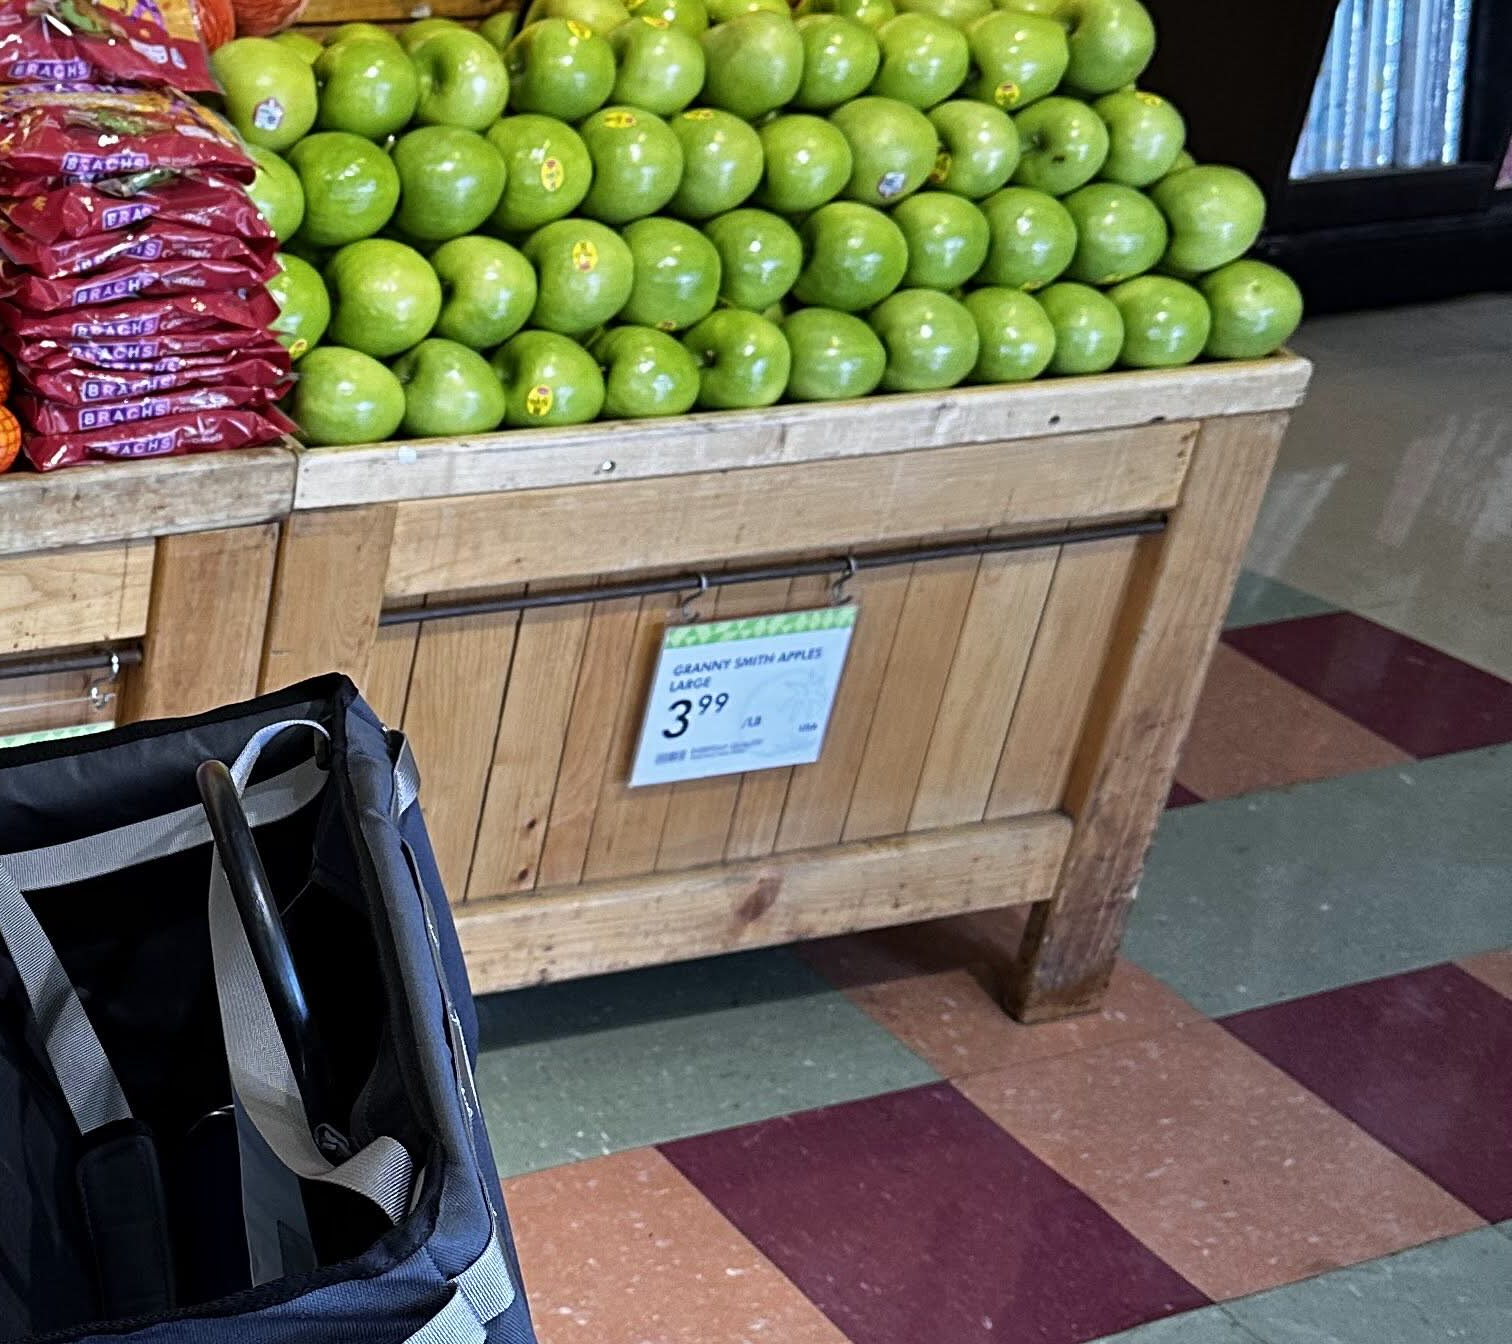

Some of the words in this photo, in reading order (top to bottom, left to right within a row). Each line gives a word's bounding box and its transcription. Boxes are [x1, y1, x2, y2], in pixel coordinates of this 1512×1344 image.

[673, 658, 732, 677] GRANNY
[734, 651, 776, 669] SMITH
[777, 646, 823, 663] APPLES
[669, 675, 712, 693] LARGE
